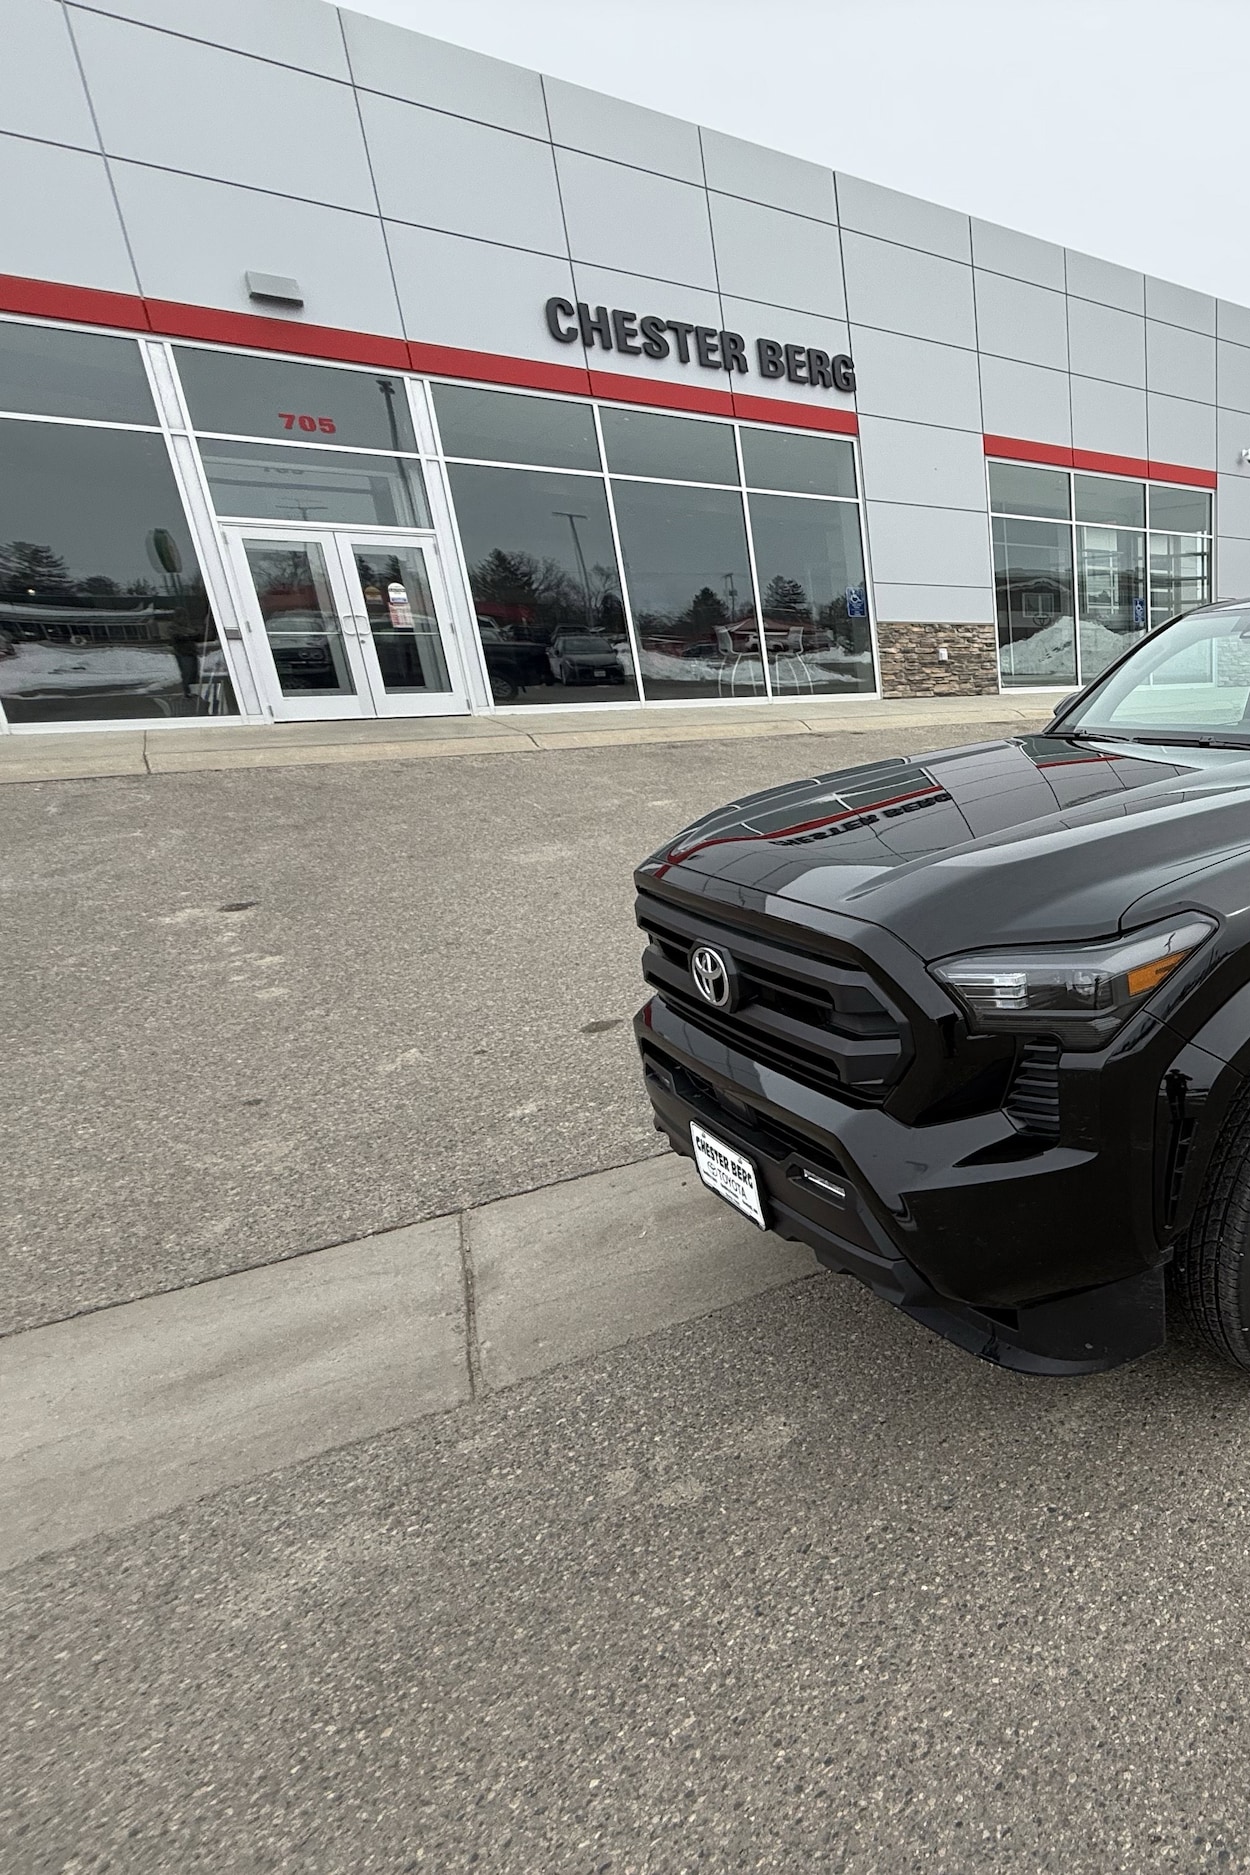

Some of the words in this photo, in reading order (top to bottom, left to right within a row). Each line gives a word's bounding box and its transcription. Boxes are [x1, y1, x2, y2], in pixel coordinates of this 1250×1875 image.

[545, 297, 749, 373] CHESTER
[756, 338, 857, 392] BERG
[278, 413, 336, 434] 705
[695, 1136, 730, 1172] CHESTER
[730, 1160, 754, 1189] BERG
[717, 1169, 748, 1200] TOYOTA
